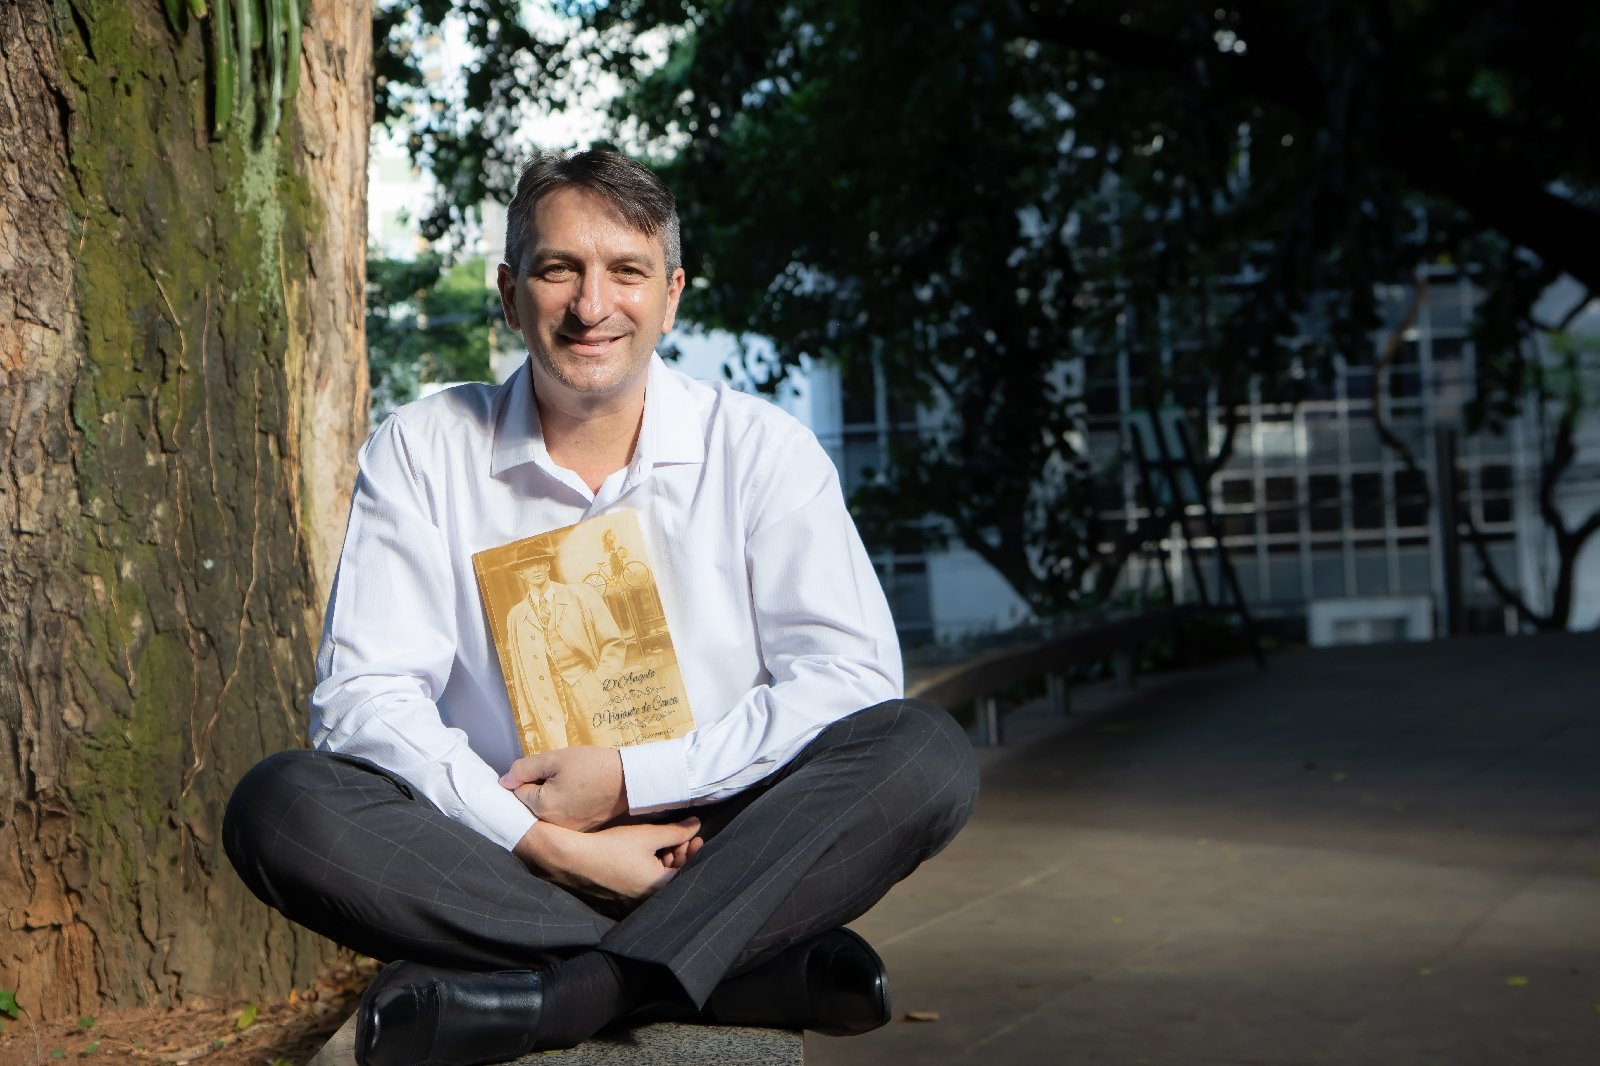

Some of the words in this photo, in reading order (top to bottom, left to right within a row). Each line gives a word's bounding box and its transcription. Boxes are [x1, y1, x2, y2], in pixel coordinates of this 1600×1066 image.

[592, 712, 602, 728] O
[603, 706, 640, 724] Viajante
[641, 701, 651, 714] de
